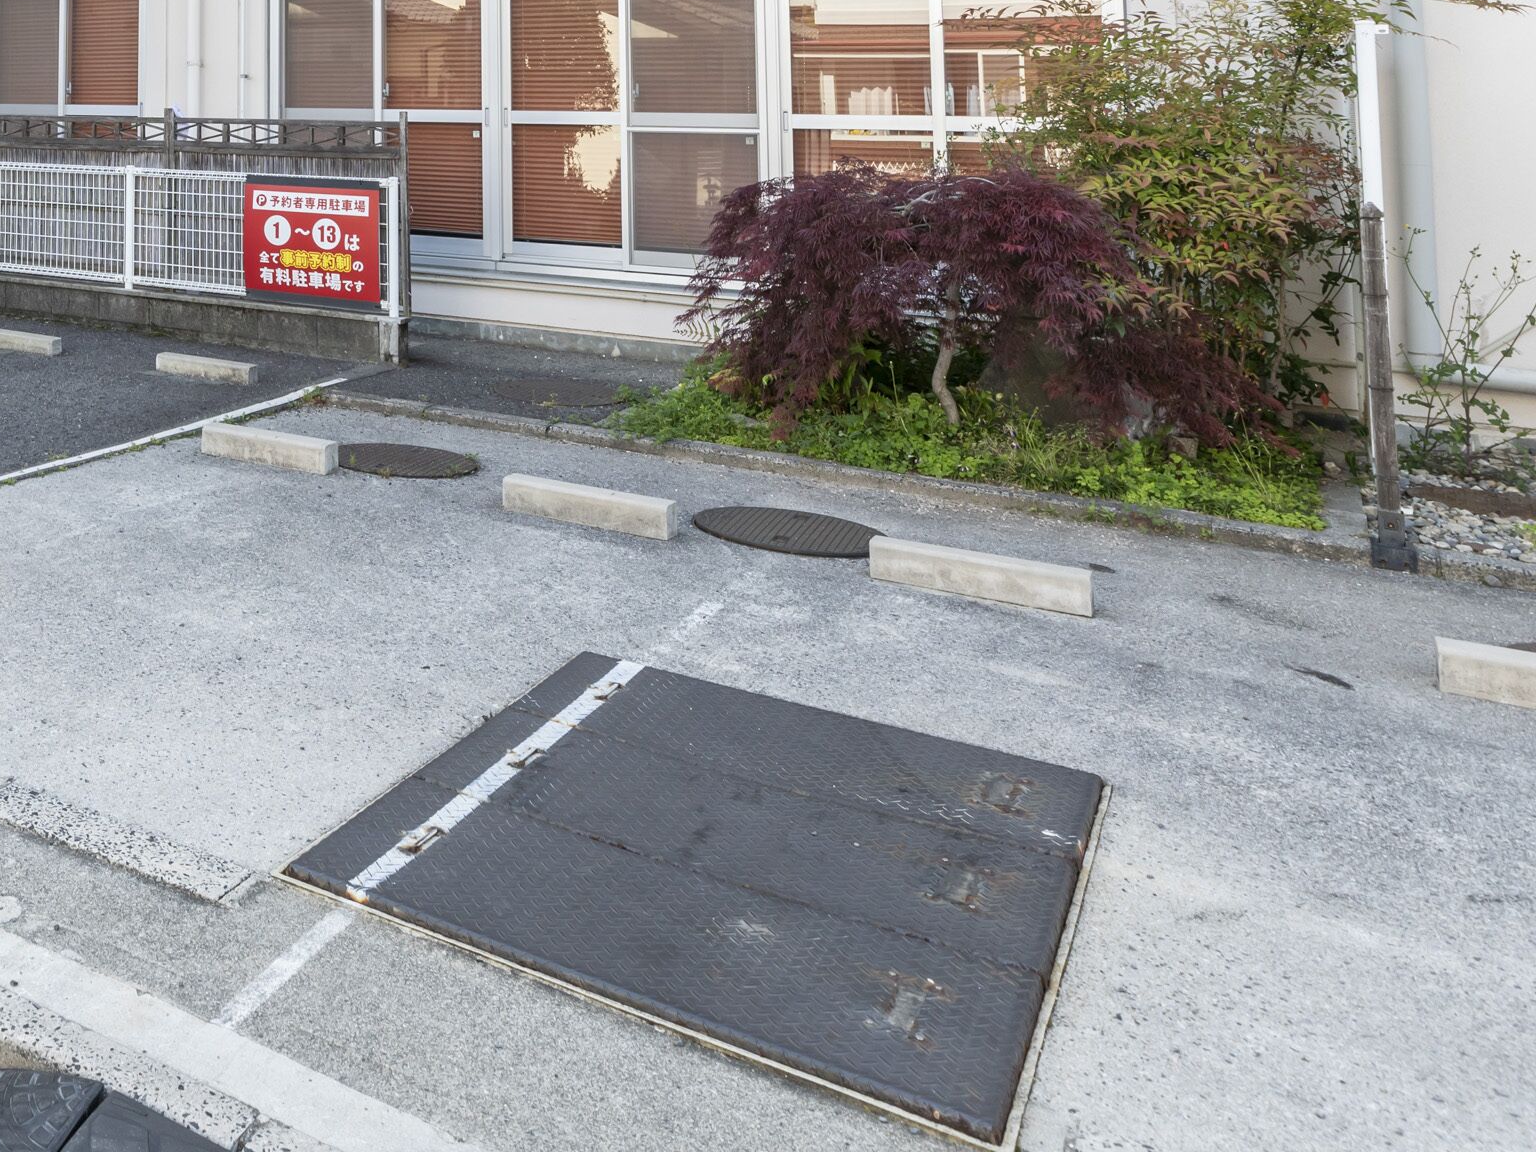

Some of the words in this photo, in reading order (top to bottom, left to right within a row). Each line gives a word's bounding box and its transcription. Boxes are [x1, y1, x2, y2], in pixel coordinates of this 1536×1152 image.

[270, 195, 366, 213] 予約者専用駐車場
[259, 249, 364, 272] 全て事前予約制の
[260, 266, 365, 293] 有料駐車場です
